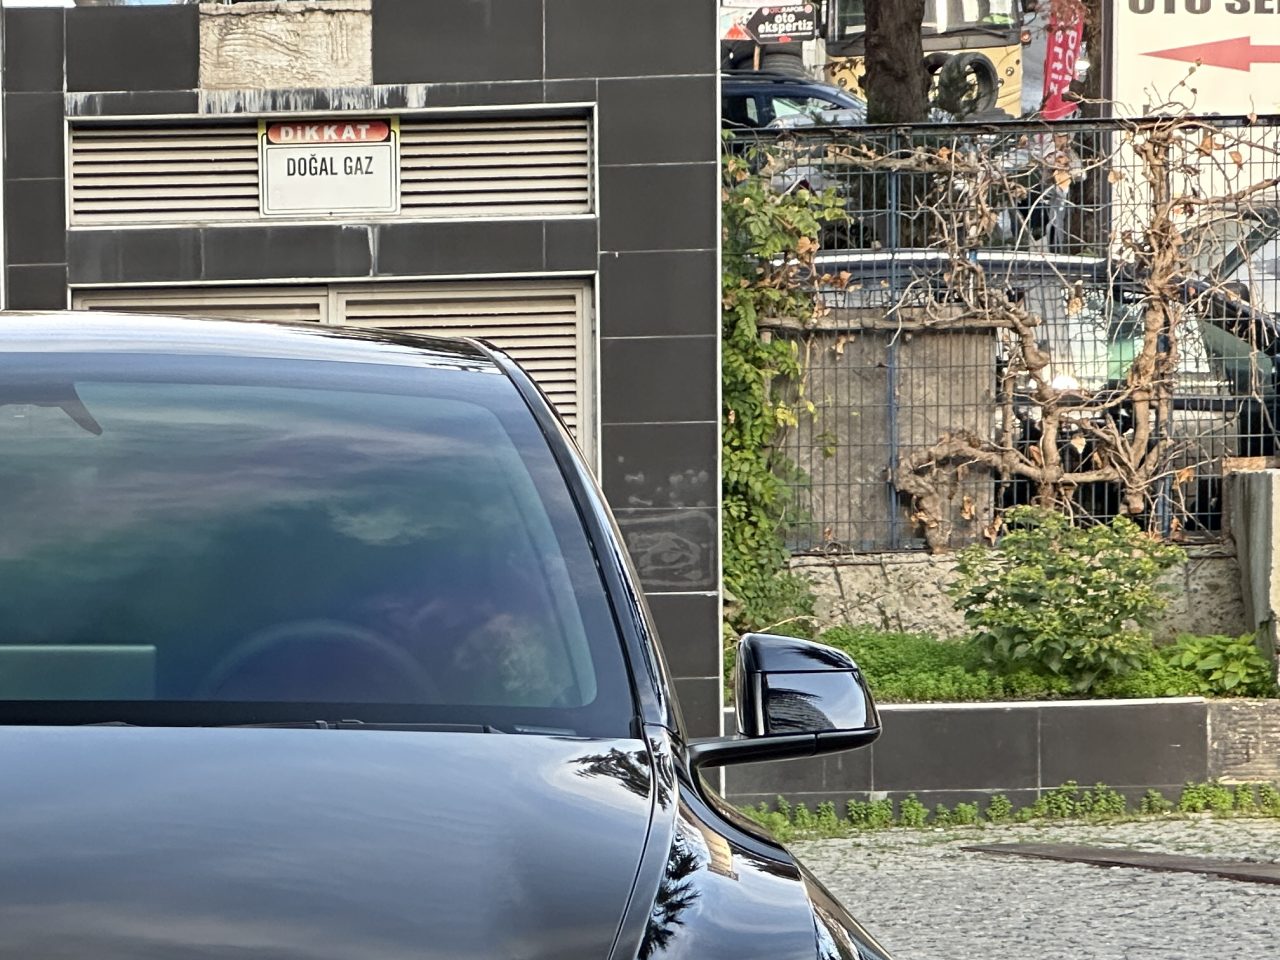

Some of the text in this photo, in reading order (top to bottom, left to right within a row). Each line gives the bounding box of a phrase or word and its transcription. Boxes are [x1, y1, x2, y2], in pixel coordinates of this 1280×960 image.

[774, 12, 796, 23] oto
[757, 19, 814, 34] ekspertiz
[287, 154, 373, 176] DOĞAL GAZ
